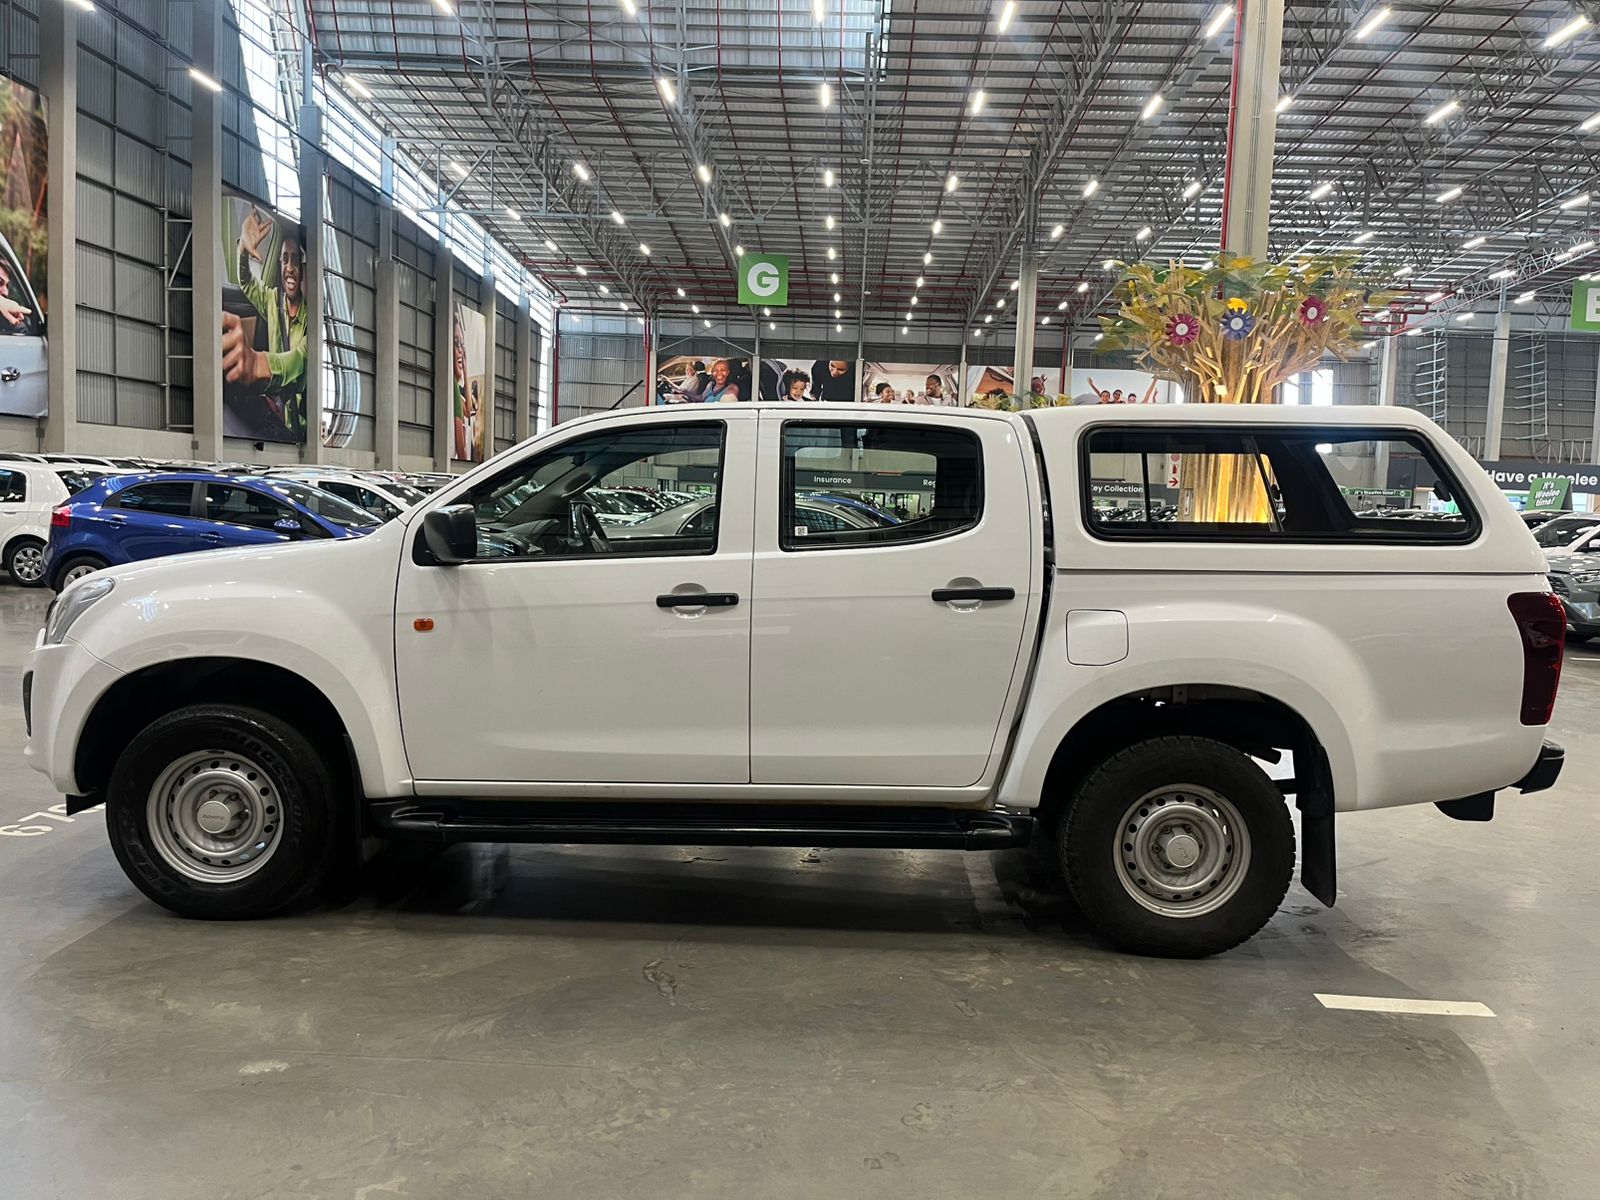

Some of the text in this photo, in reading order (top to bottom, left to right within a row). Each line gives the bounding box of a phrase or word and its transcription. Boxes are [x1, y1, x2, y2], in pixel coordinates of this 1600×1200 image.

[747, 262, 780, 297] G
[813, 475, 852, 485] Insurance
[1485, 469, 1525, 483] Have
[1091, 484, 1144, 494] ey Collection
[1542, 481, 1555, 490] It's
[1535, 496, 1556, 507] time!
